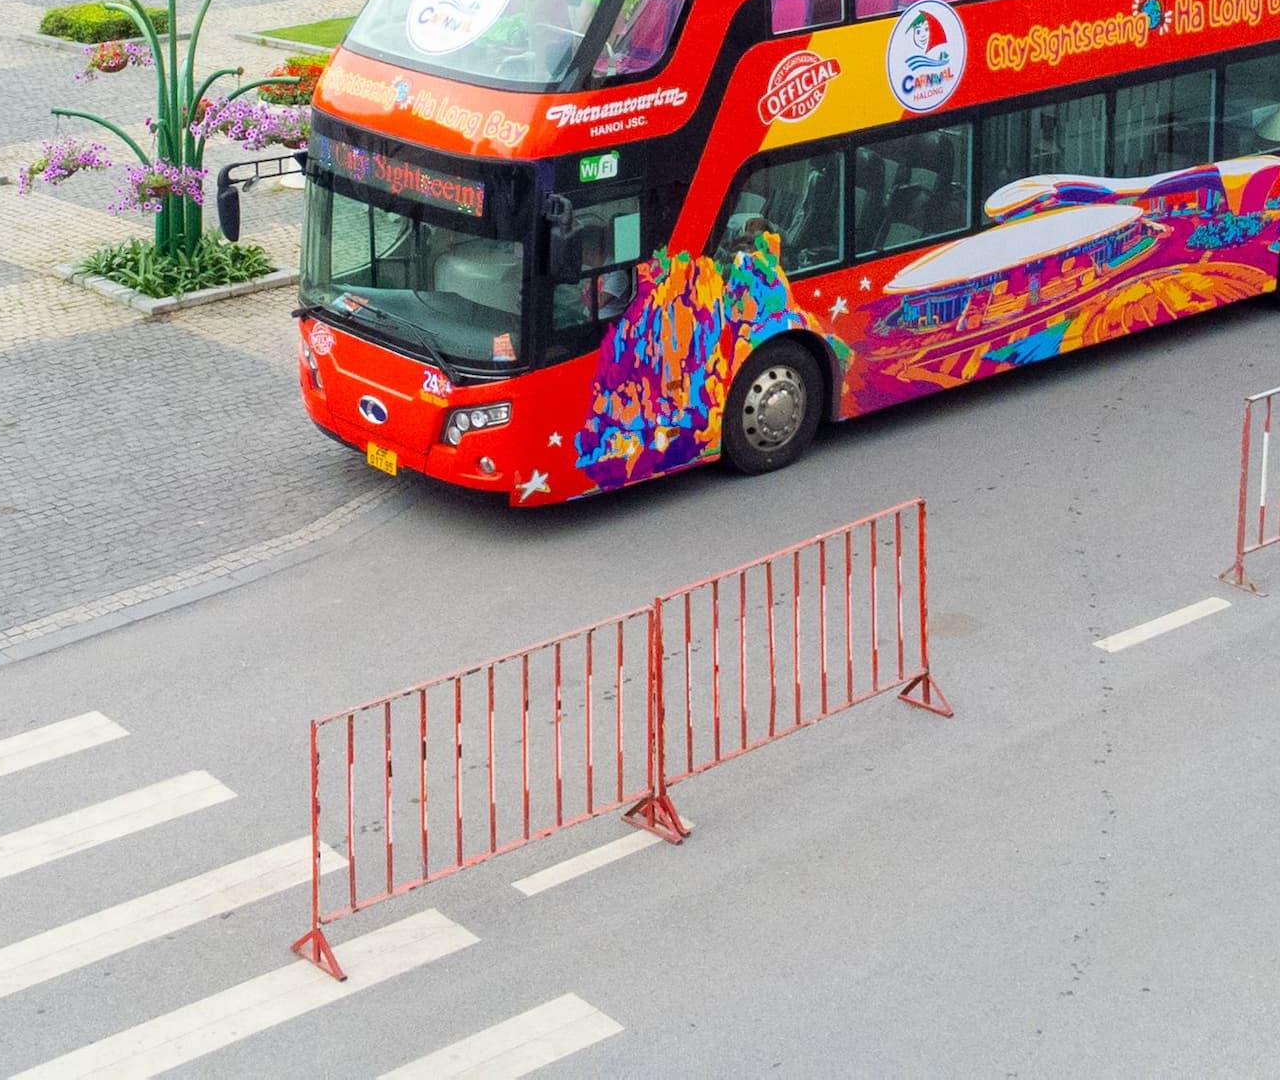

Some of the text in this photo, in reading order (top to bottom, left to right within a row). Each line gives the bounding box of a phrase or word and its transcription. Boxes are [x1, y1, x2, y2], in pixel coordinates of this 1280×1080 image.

[767, 61, 838, 115] OFFICIAL
[791, 89, 823, 117] TOUR
[437, 95, 482, 138] Long
[483, 109, 530, 148] Bay
[590, 121, 624, 137] HANOI
